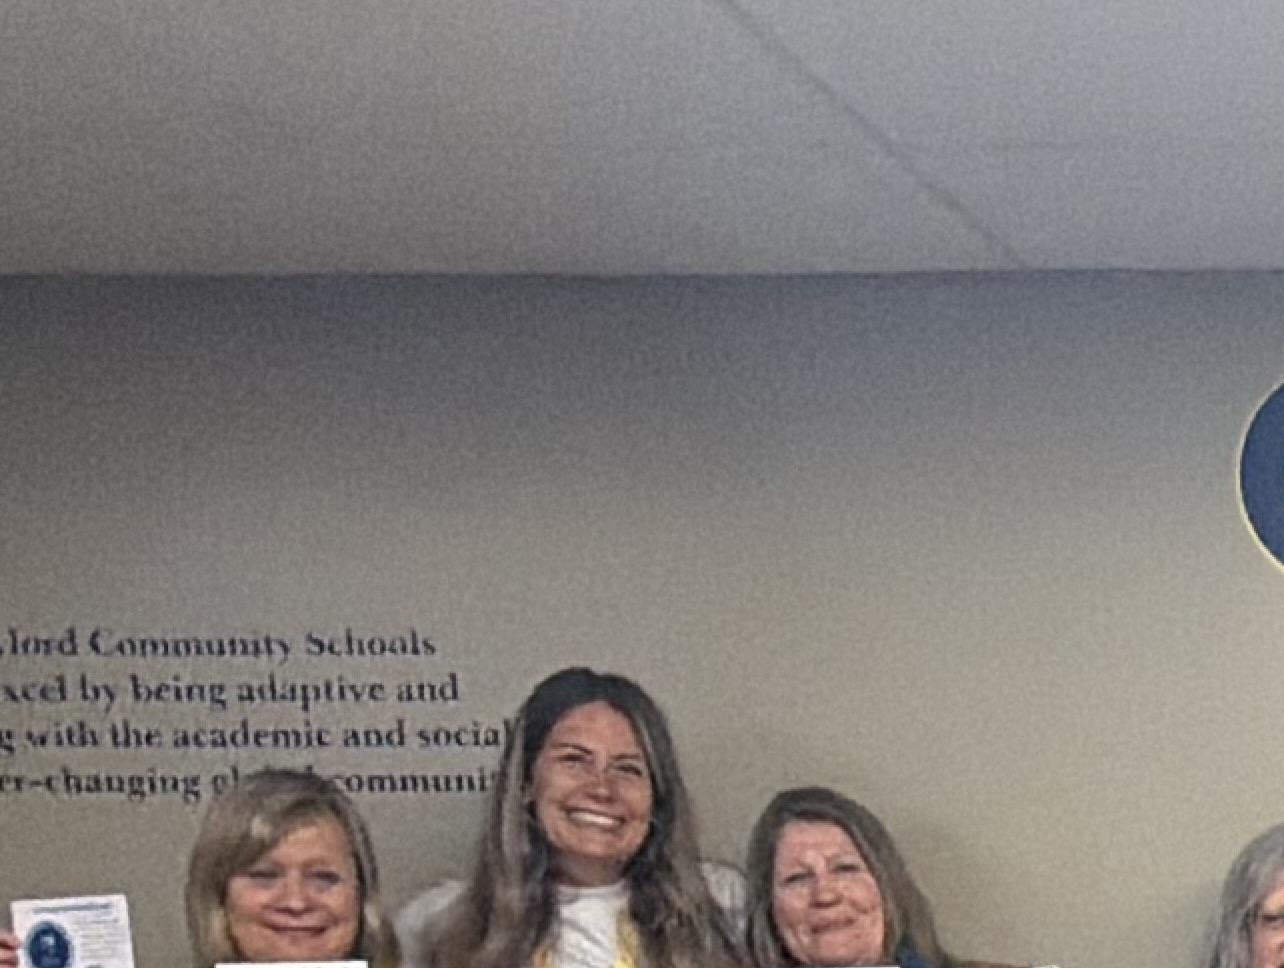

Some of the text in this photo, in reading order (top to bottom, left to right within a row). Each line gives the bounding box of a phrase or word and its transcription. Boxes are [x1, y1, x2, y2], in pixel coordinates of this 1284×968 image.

[89, 628, 290, 666] Community
[306, 627, 436, 657] Schools
[80, 673, 115, 714] by
[130, 673, 227, 711] being
[238, 671, 386, 714] adaptive
[397, 672, 460, 702] and
[26, 720, 98, 749] with
[110, 718, 162, 749] the
[173, 718, 331, 749] academic
[343, 718, 406, 748] and
